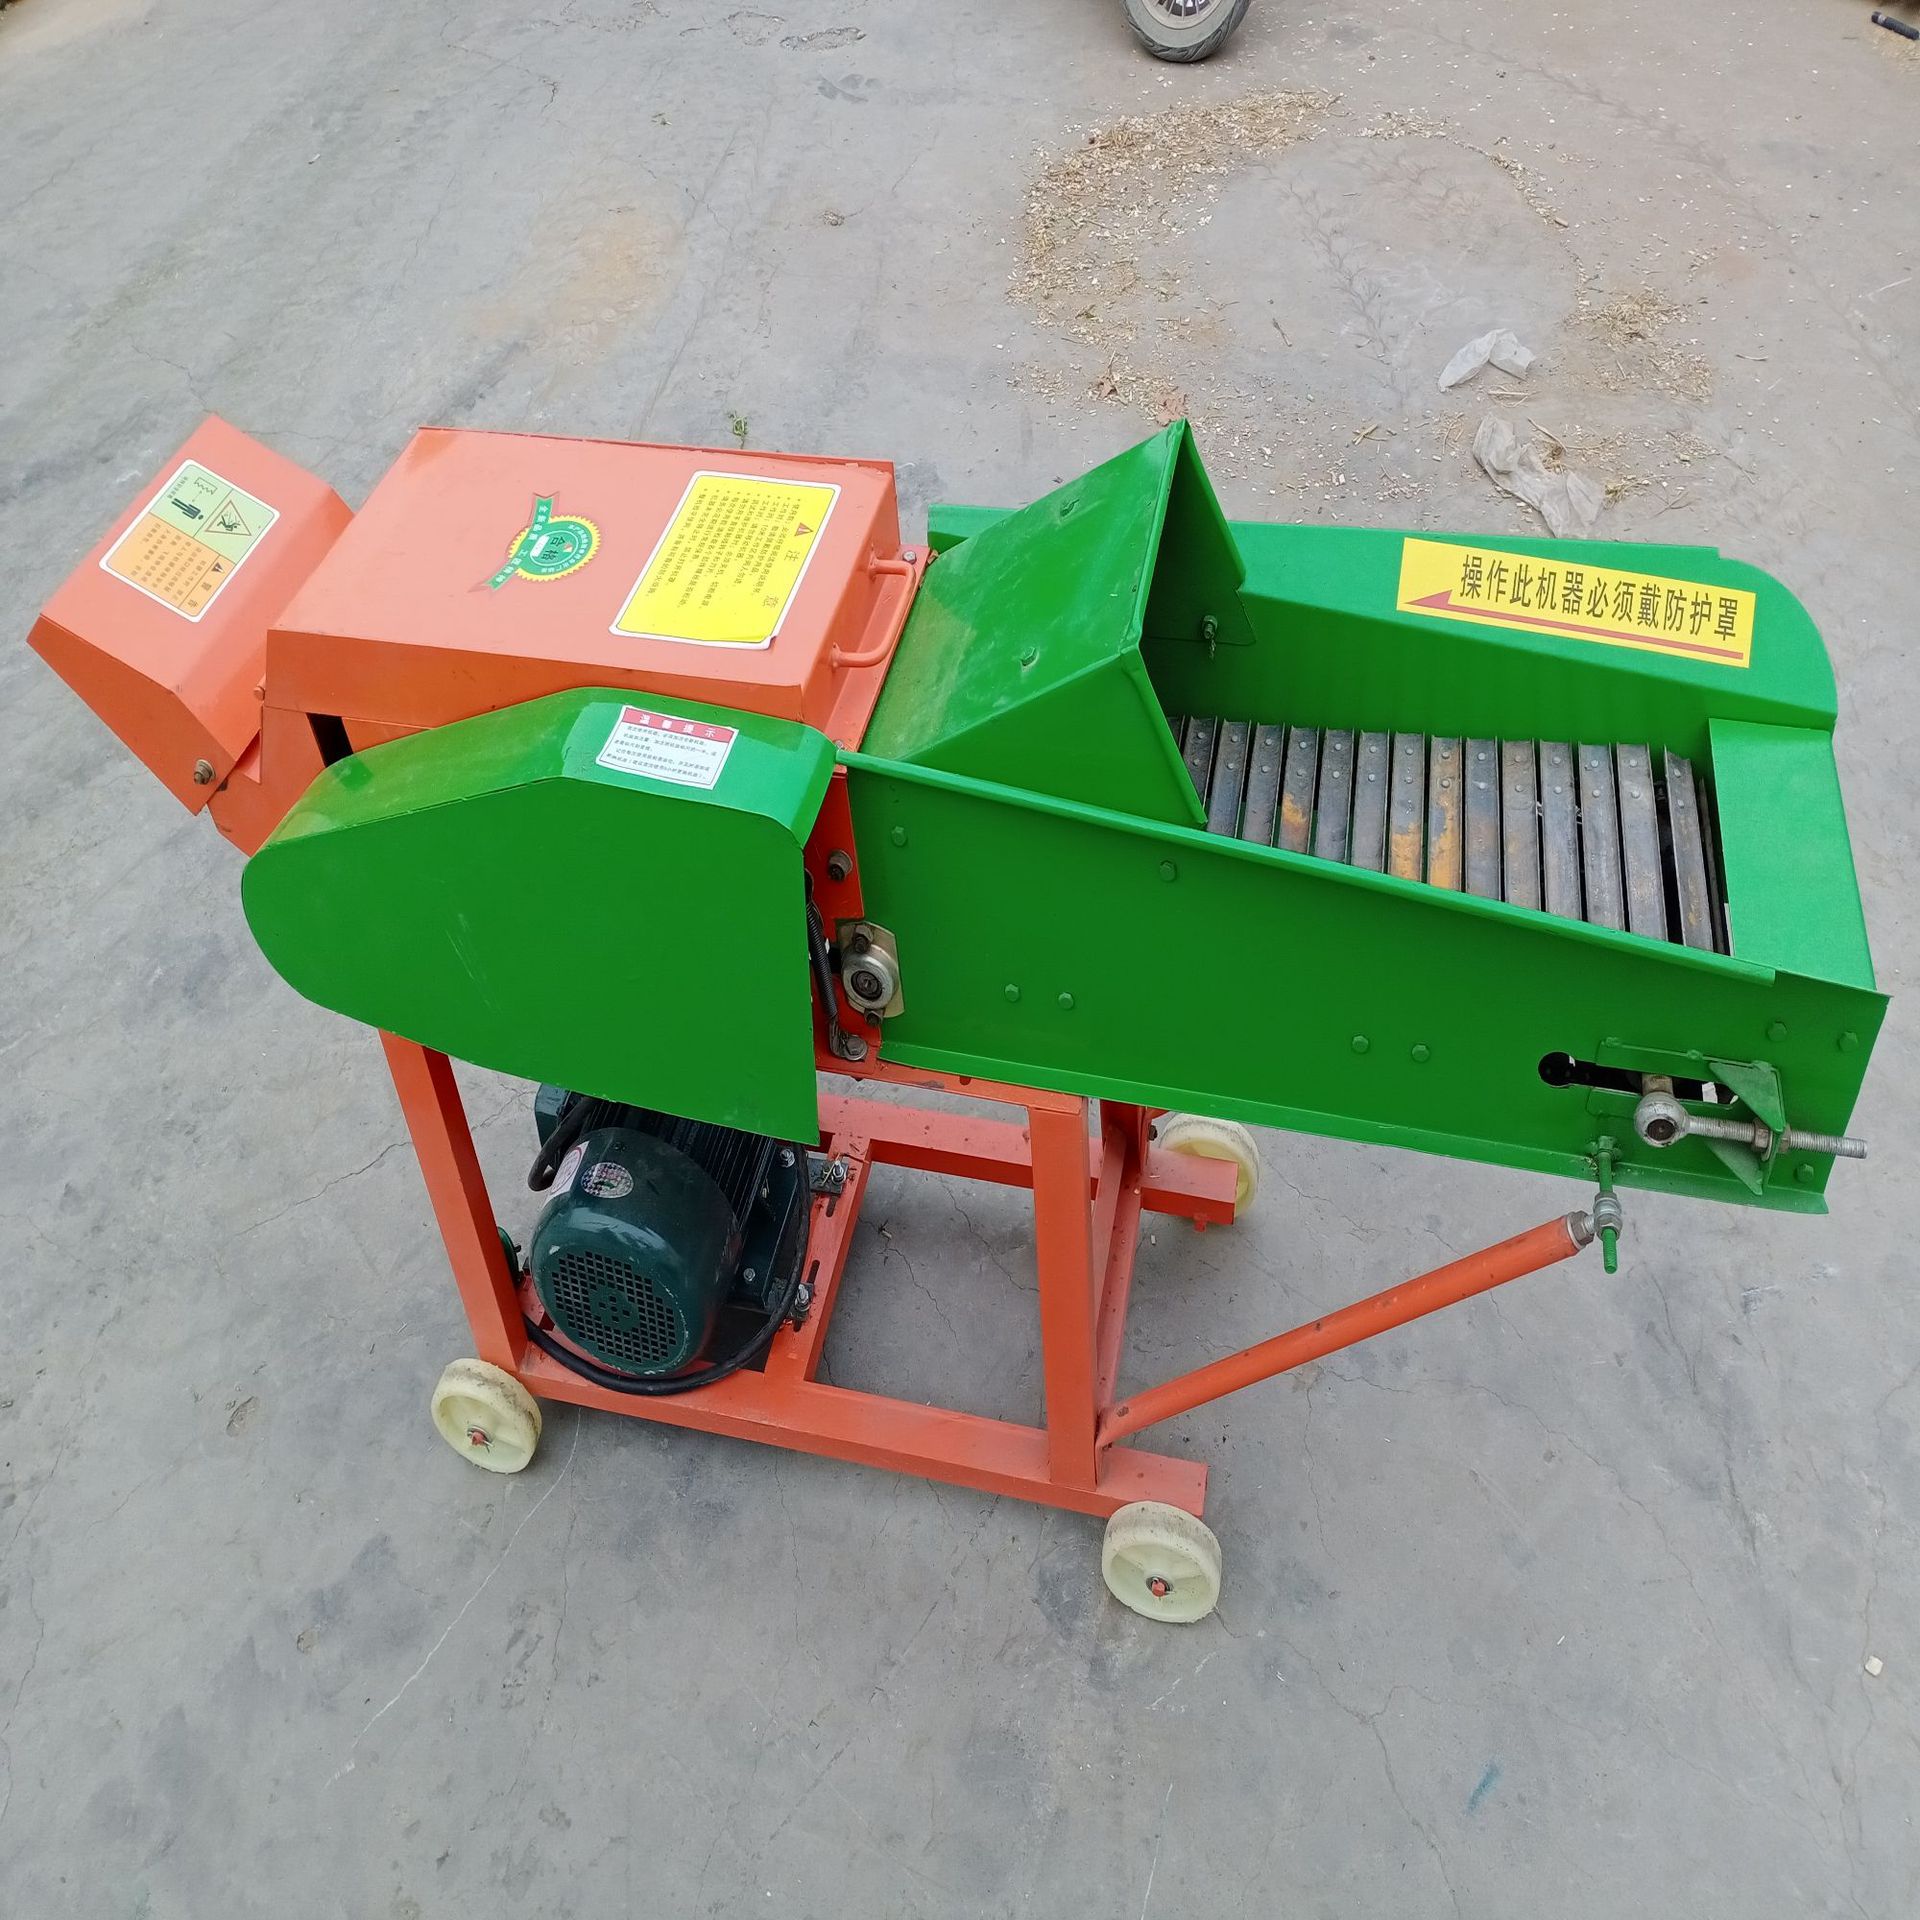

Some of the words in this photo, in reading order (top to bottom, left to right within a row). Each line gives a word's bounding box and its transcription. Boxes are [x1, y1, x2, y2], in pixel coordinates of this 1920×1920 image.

[541, 537, 566, 560] 合格
[1460, 553, 1739, 642] 操作此机器必须戴防护罩
